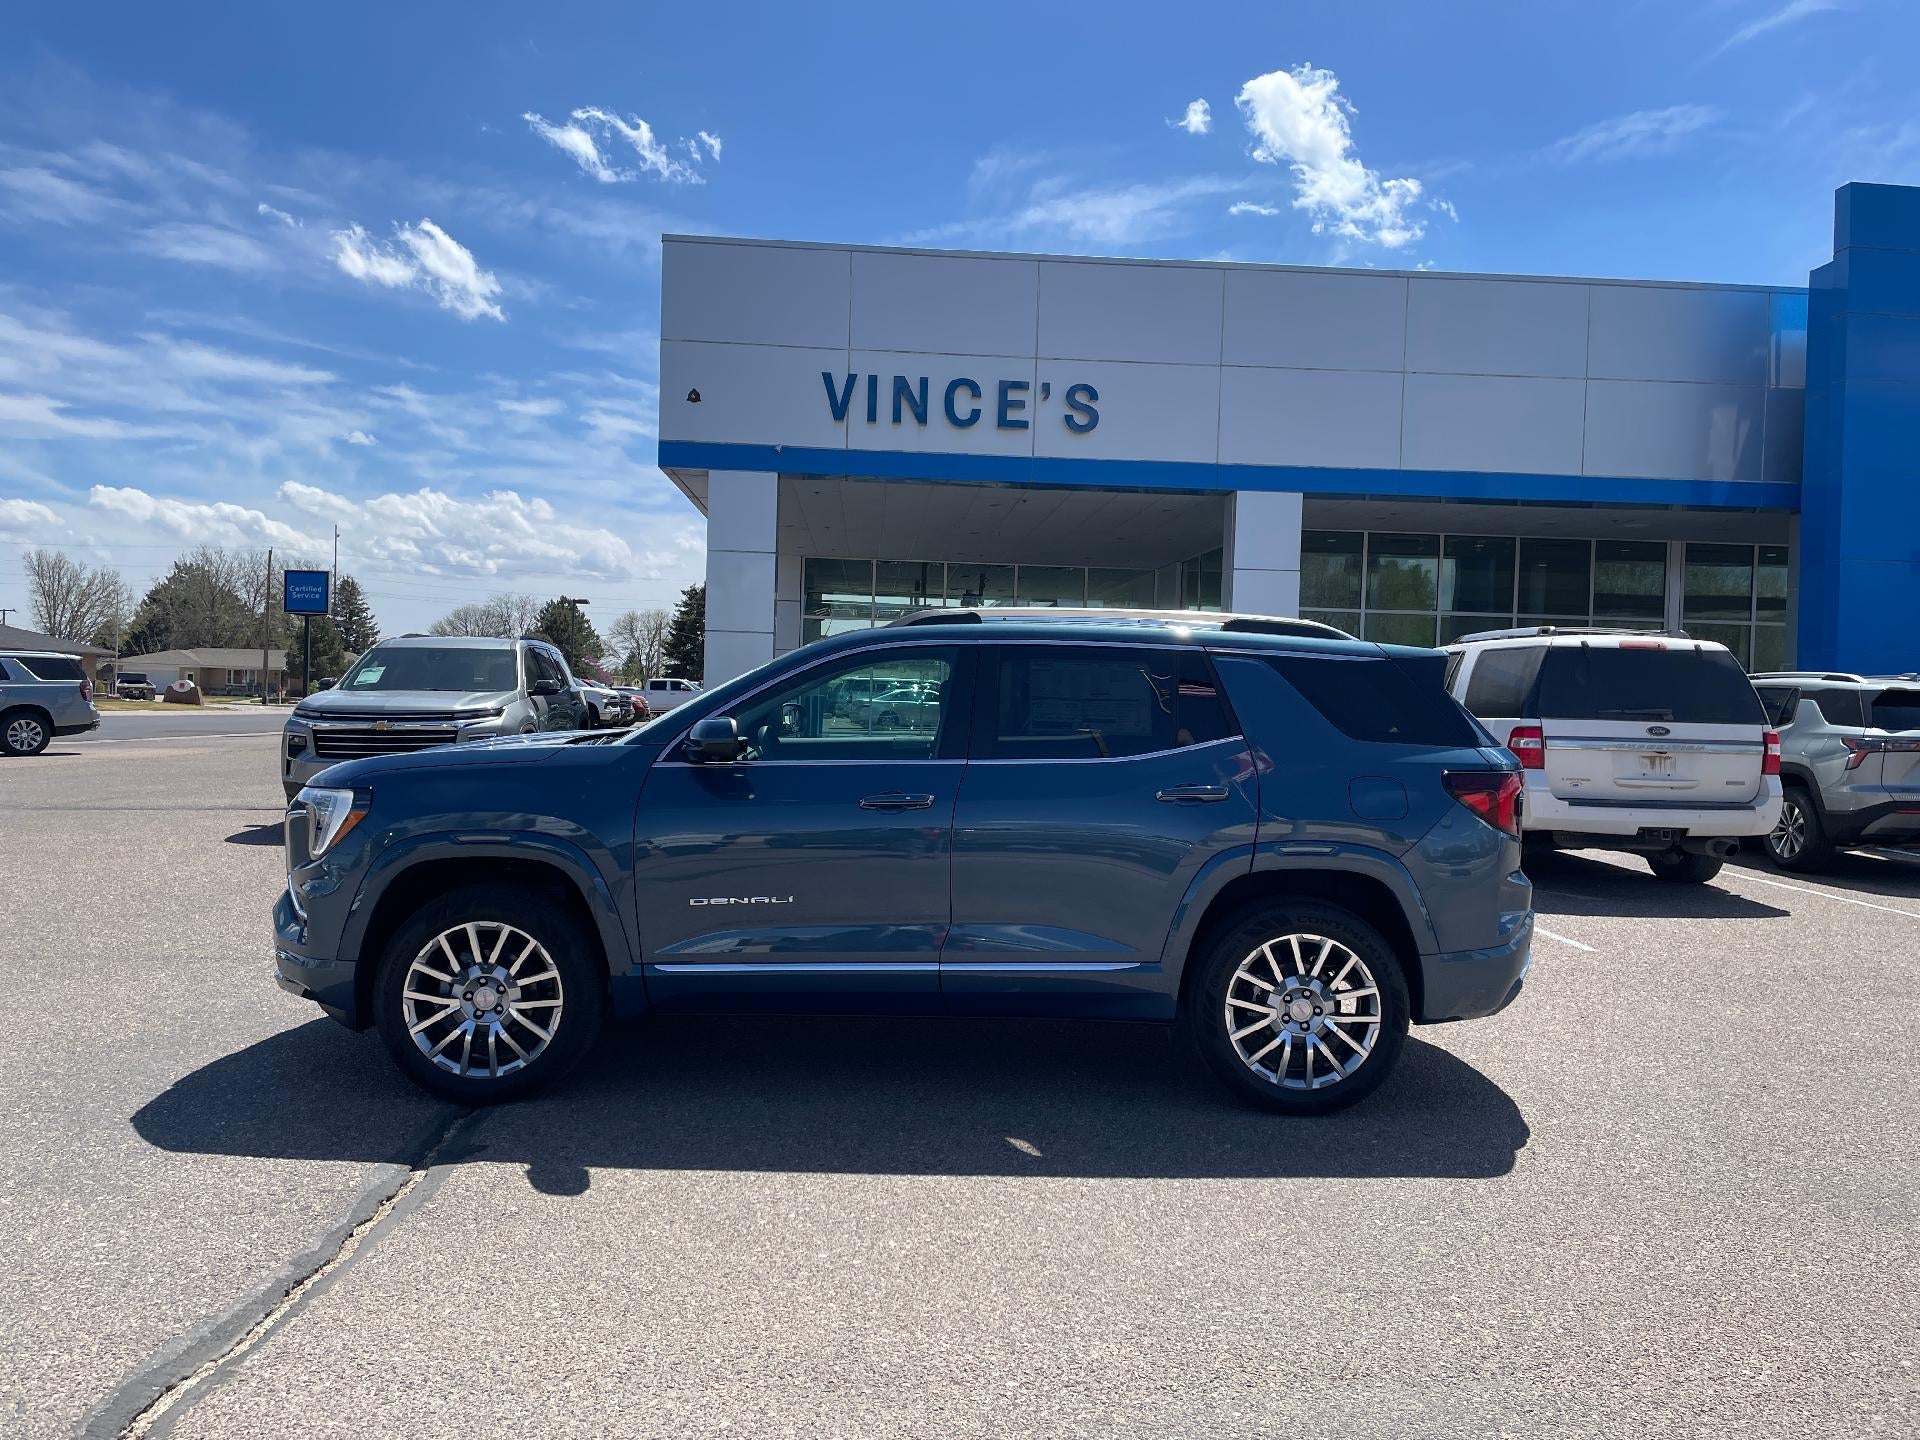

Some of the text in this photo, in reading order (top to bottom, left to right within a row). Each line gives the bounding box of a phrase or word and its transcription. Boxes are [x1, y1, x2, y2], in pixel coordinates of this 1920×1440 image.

[821, 371, 1100, 434] VINCE'S
[289, 585, 322, 593] Certified
[690, 895, 794, 906] DENALI
